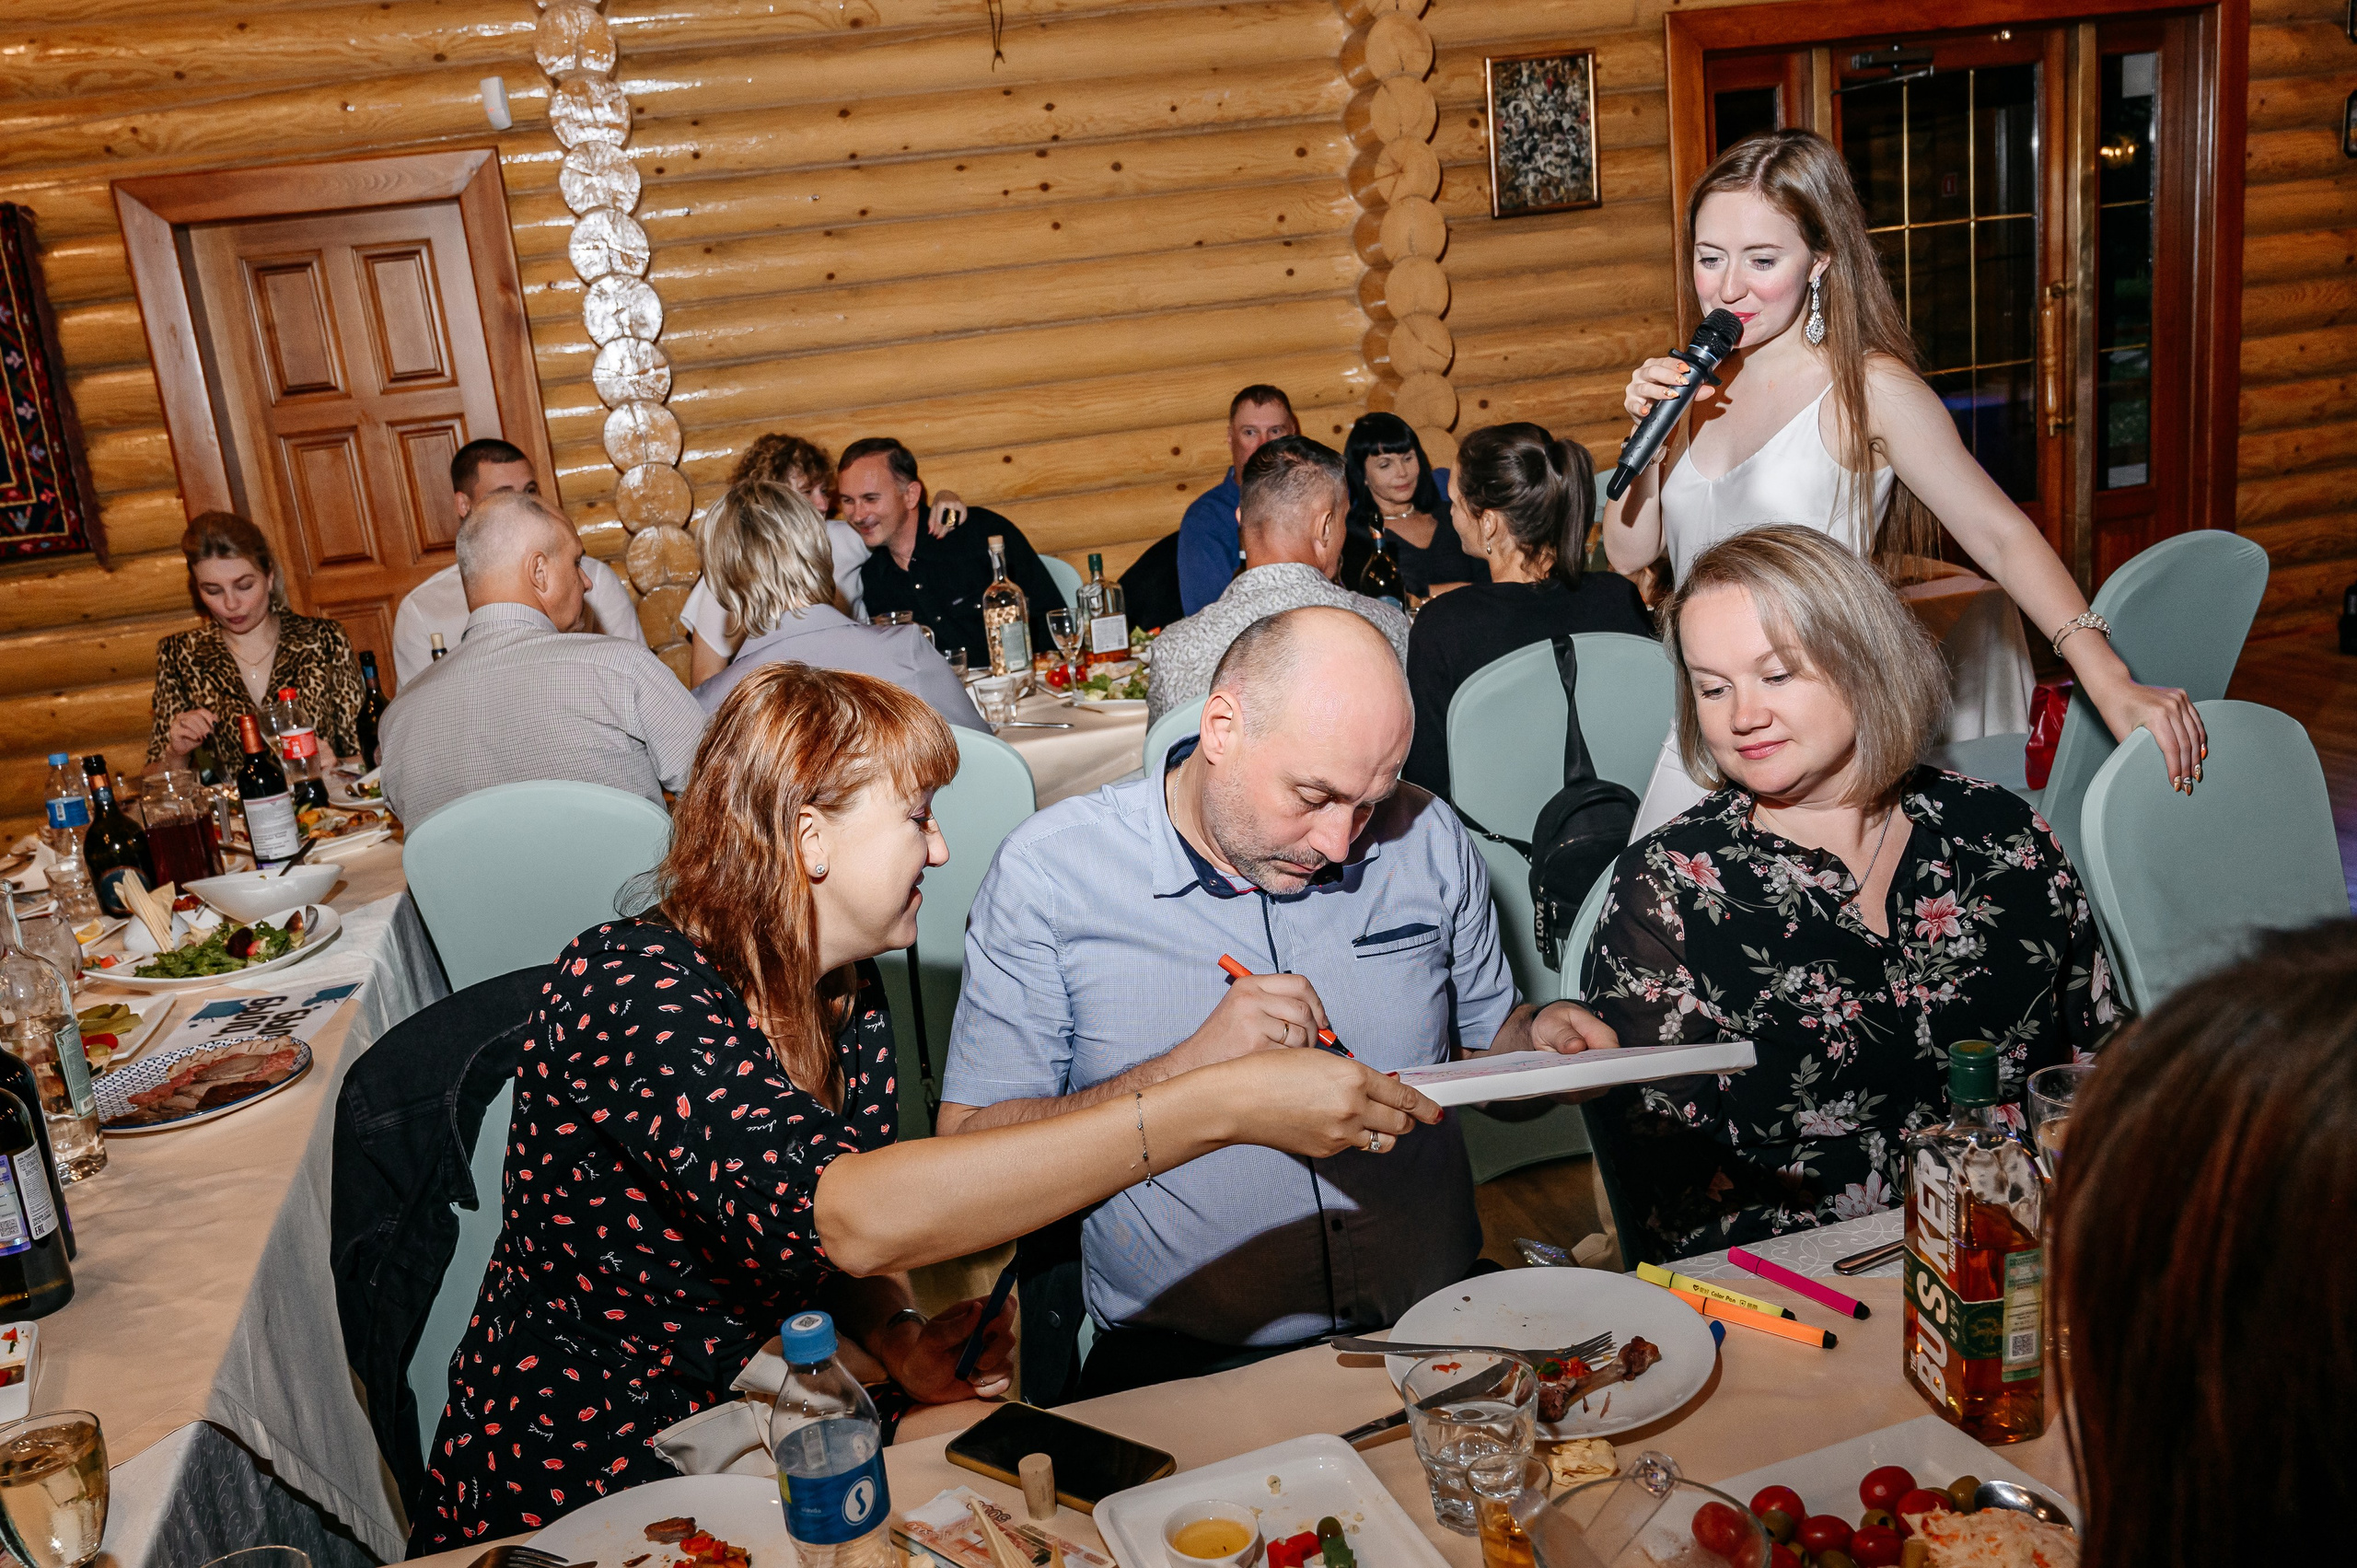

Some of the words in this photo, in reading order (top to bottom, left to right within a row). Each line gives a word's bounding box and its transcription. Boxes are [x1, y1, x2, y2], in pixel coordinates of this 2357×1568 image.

[1536, 901, 1545, 937] LOVE
[1947, 1176, 1957, 1236] WHISKEY
[1948, 1236, 1956, 1272] IRISH
[1711, 1291, 1724, 1299] Color
[1910, 1350, 1918, 1372] THE
[1916, 1148, 1948, 1408] BUSKER
